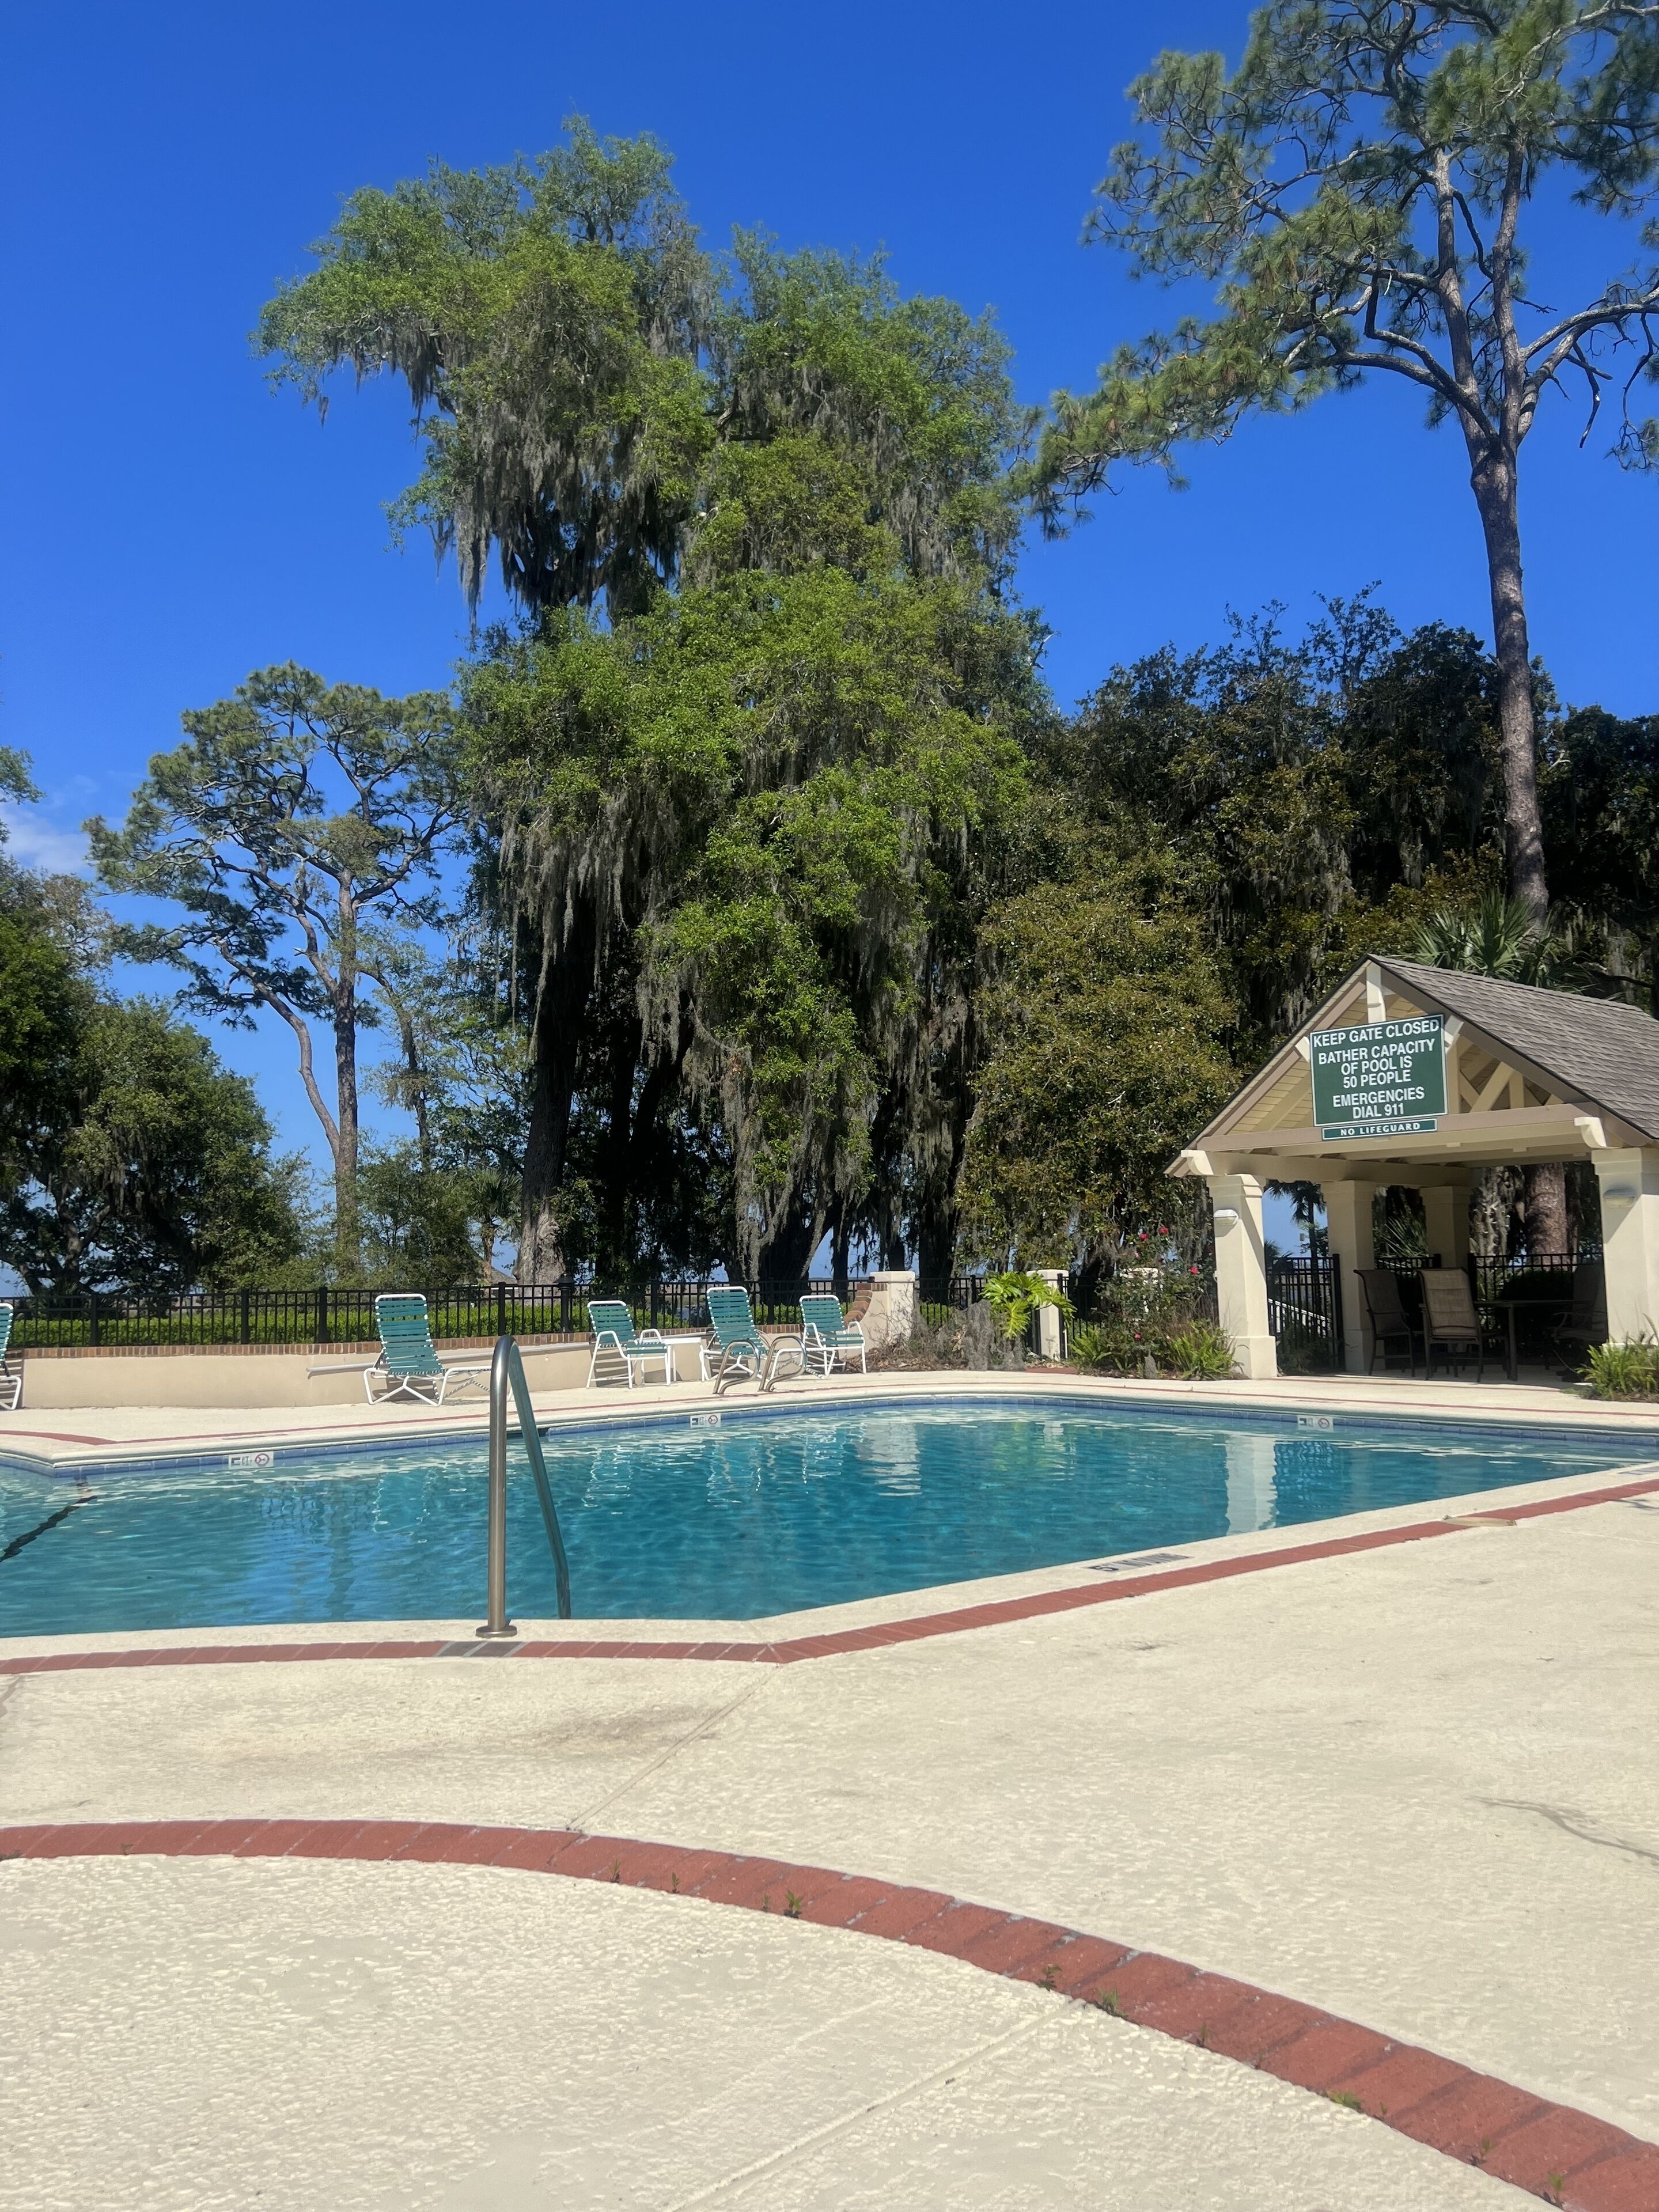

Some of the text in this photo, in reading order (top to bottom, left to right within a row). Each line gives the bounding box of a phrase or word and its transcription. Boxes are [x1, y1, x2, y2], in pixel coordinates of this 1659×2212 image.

[1313, 1019, 1439, 1047] KEEP GATE CLOSED
[1319, 1039, 1435, 1065] BATHER CAPACITY
[1341, 1055, 1412, 1075] OF POOL IS
[1343, 1070, 1411, 1088] 50 PEOPLE
[1333, 1086, 1425, 1107] EMERGENCIES
[1353, 1103, 1404, 1119] DIAL 911
[1340, 1123, 1421, 1136] NO LIFEGUARD
